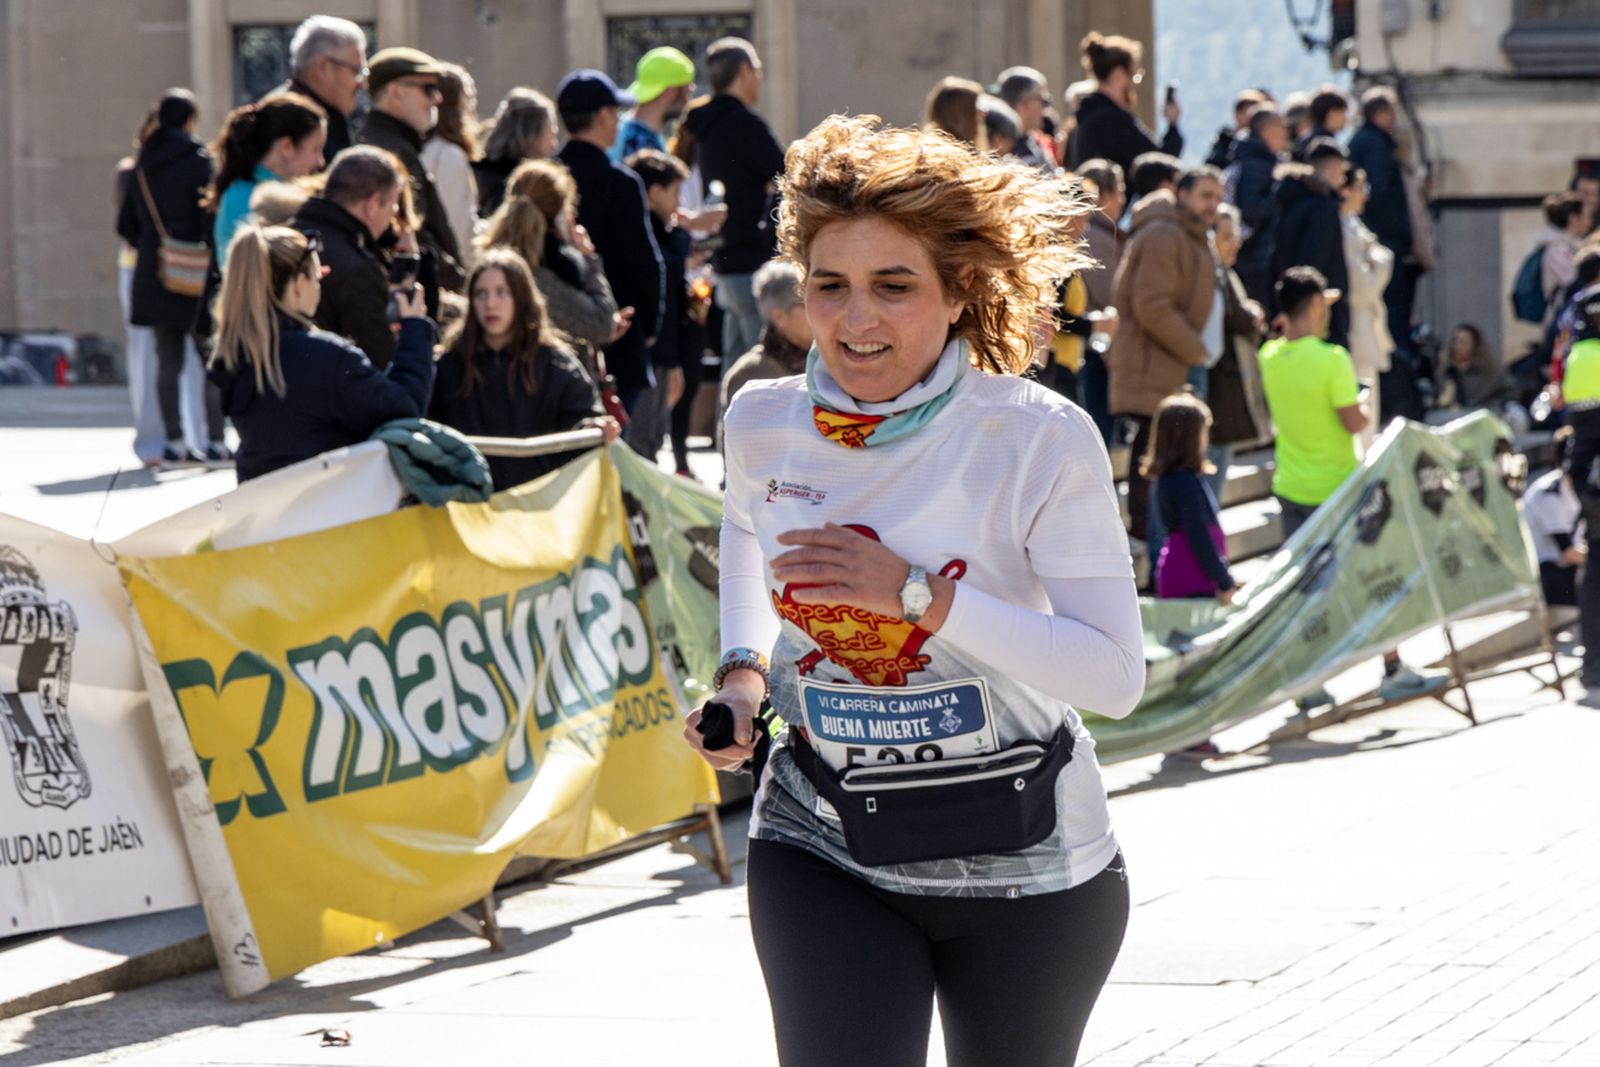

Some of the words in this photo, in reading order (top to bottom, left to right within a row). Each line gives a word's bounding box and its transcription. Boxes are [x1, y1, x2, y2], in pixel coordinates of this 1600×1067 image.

[817, 695, 830, 708] VI
[830, 696, 886, 713] CARRERA
[888, 691, 960, 714] CAMINATA
[820, 715, 866, 739] BUENA
[869, 717, 933, 740] MUERTE
[67, 826, 94, 858] DE
[98, 815, 145, 853] JAÉN
